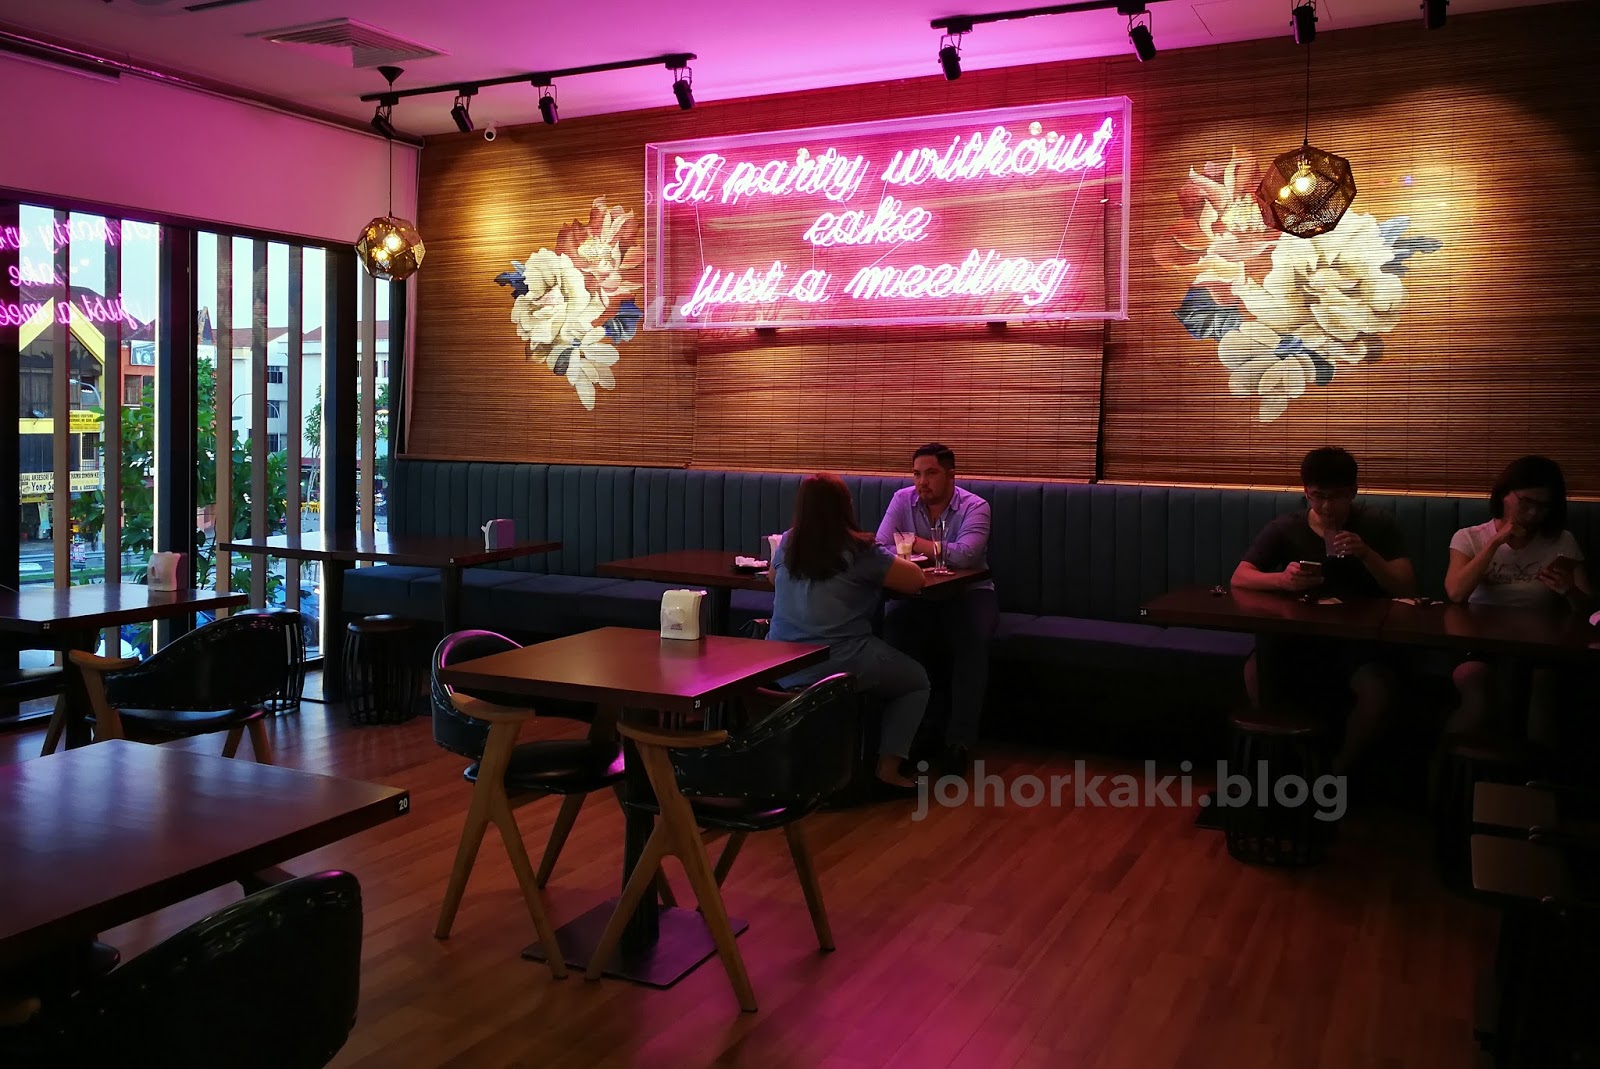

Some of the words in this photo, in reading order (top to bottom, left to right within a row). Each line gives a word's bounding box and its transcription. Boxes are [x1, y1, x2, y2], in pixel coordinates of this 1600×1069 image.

[663, 154, 725, 203] A
[721, 147, 869, 205] party
[881, 116, 1113, 185] without
[803, 195, 931, 247] cake
[680, 260, 788, 317] just
[790, 269, 832, 303] a
[844, 248, 1070, 307] meeting
[398, 797, 408, 811] 20
